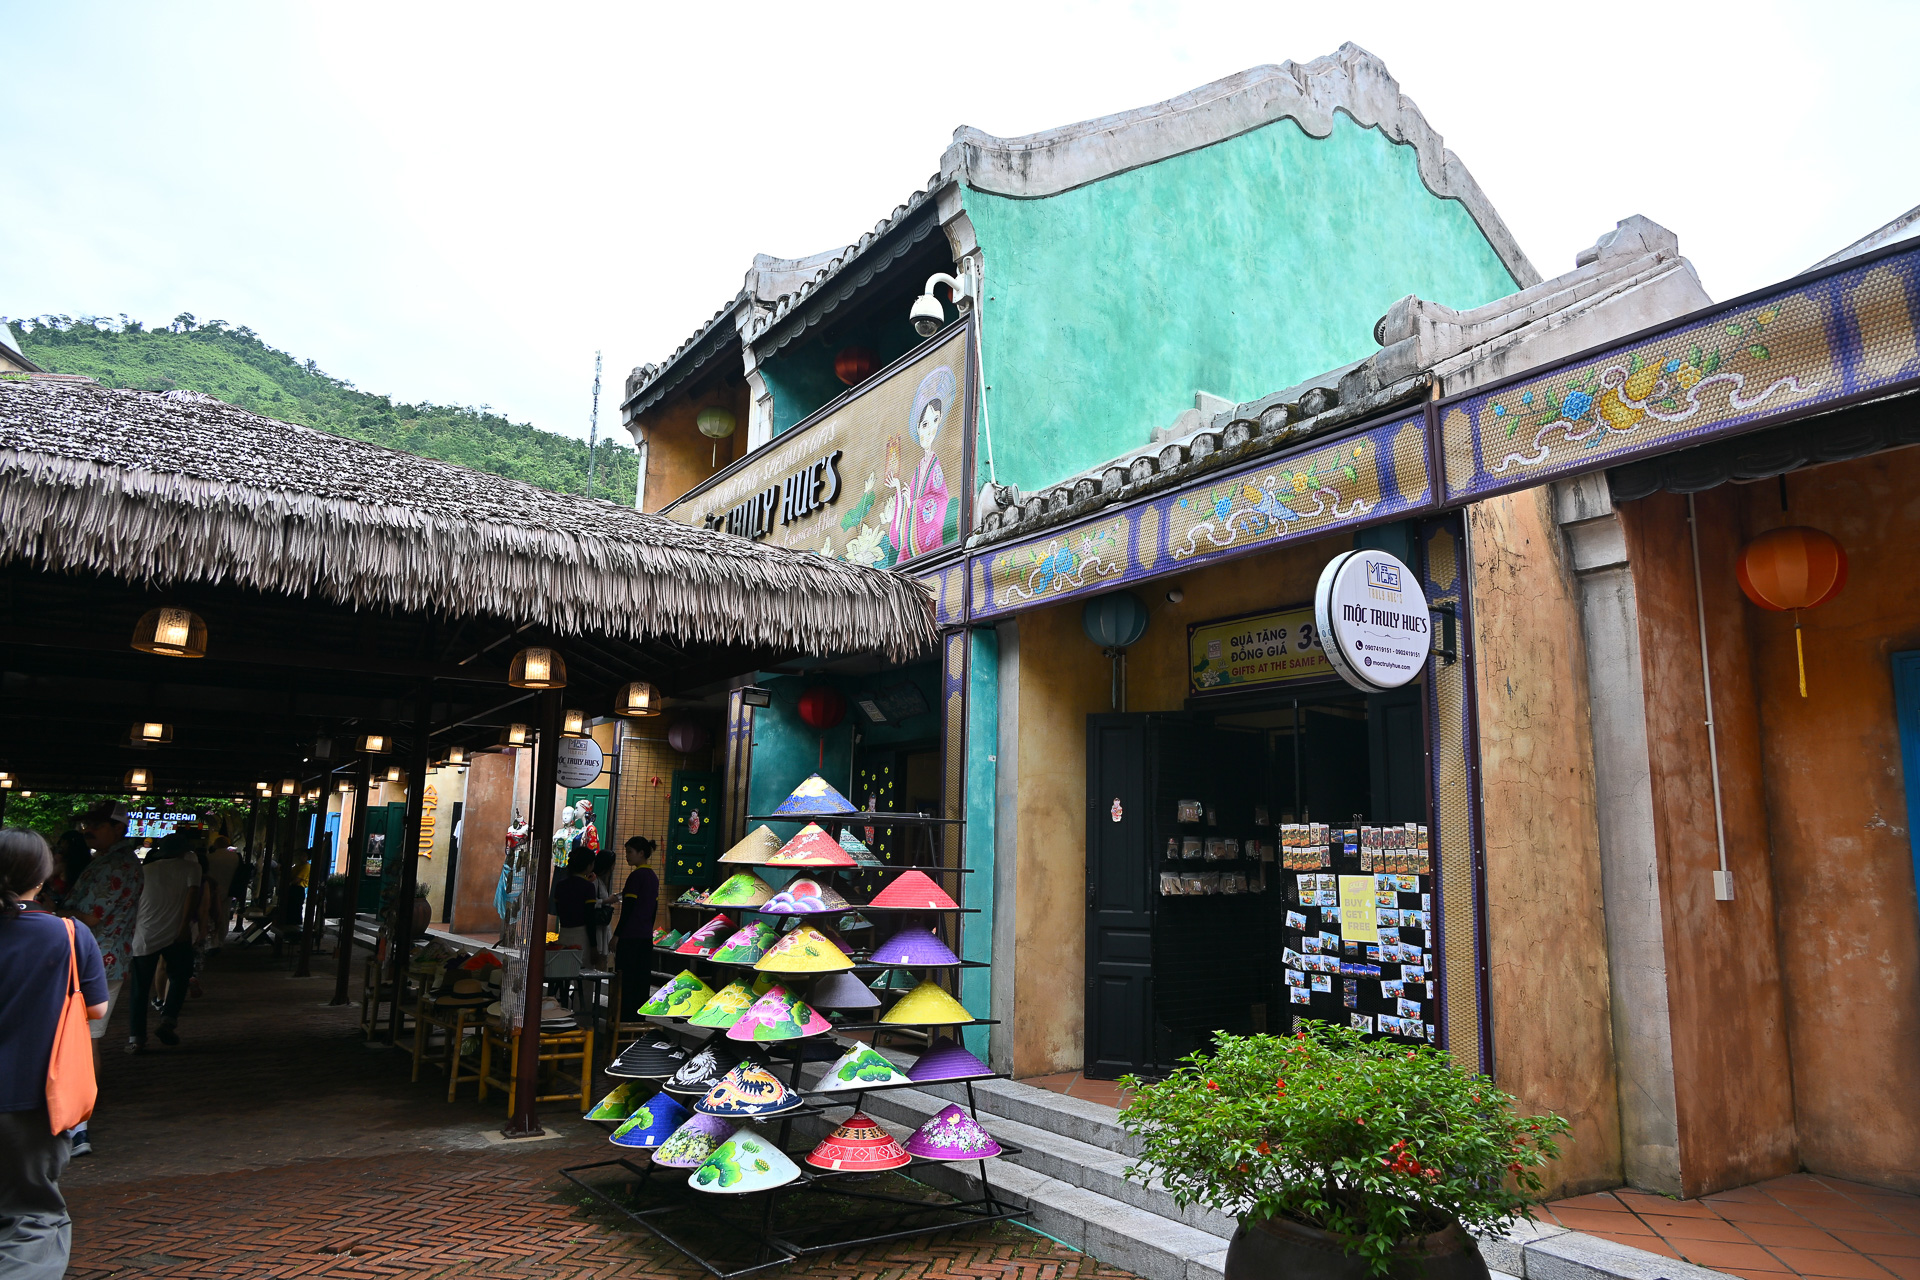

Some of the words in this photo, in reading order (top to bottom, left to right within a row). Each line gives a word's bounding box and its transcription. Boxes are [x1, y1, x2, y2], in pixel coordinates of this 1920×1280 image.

[780, 450, 843, 526] HUE'S
[1343, 603, 1367, 626] MỘC
[1370, 608, 1400, 629] TRULY
[1230, 631, 1254, 648] QUÀ
[1256, 628, 1288, 645] TẶNG
[1230, 645, 1264, 663] ĐỒNG
[1266, 641, 1288, 657] GIÁ
[1231, 664, 1256, 676] GIFTS
[1257, 662, 1269, 673] AT
[1270, 660, 1287, 671] THE
[1289, 656, 1316, 669] SAME
[1373, 661, 1411, 670] moctrulyhue.com
[1345, 899, 1363, 908] BUY
[1365, 899, 1371, 908] 4
[1346, 910, 1363, 919] GET
[1365, 911, 1369, 919] 1
[1348, 922, 1370, 931] FREE
